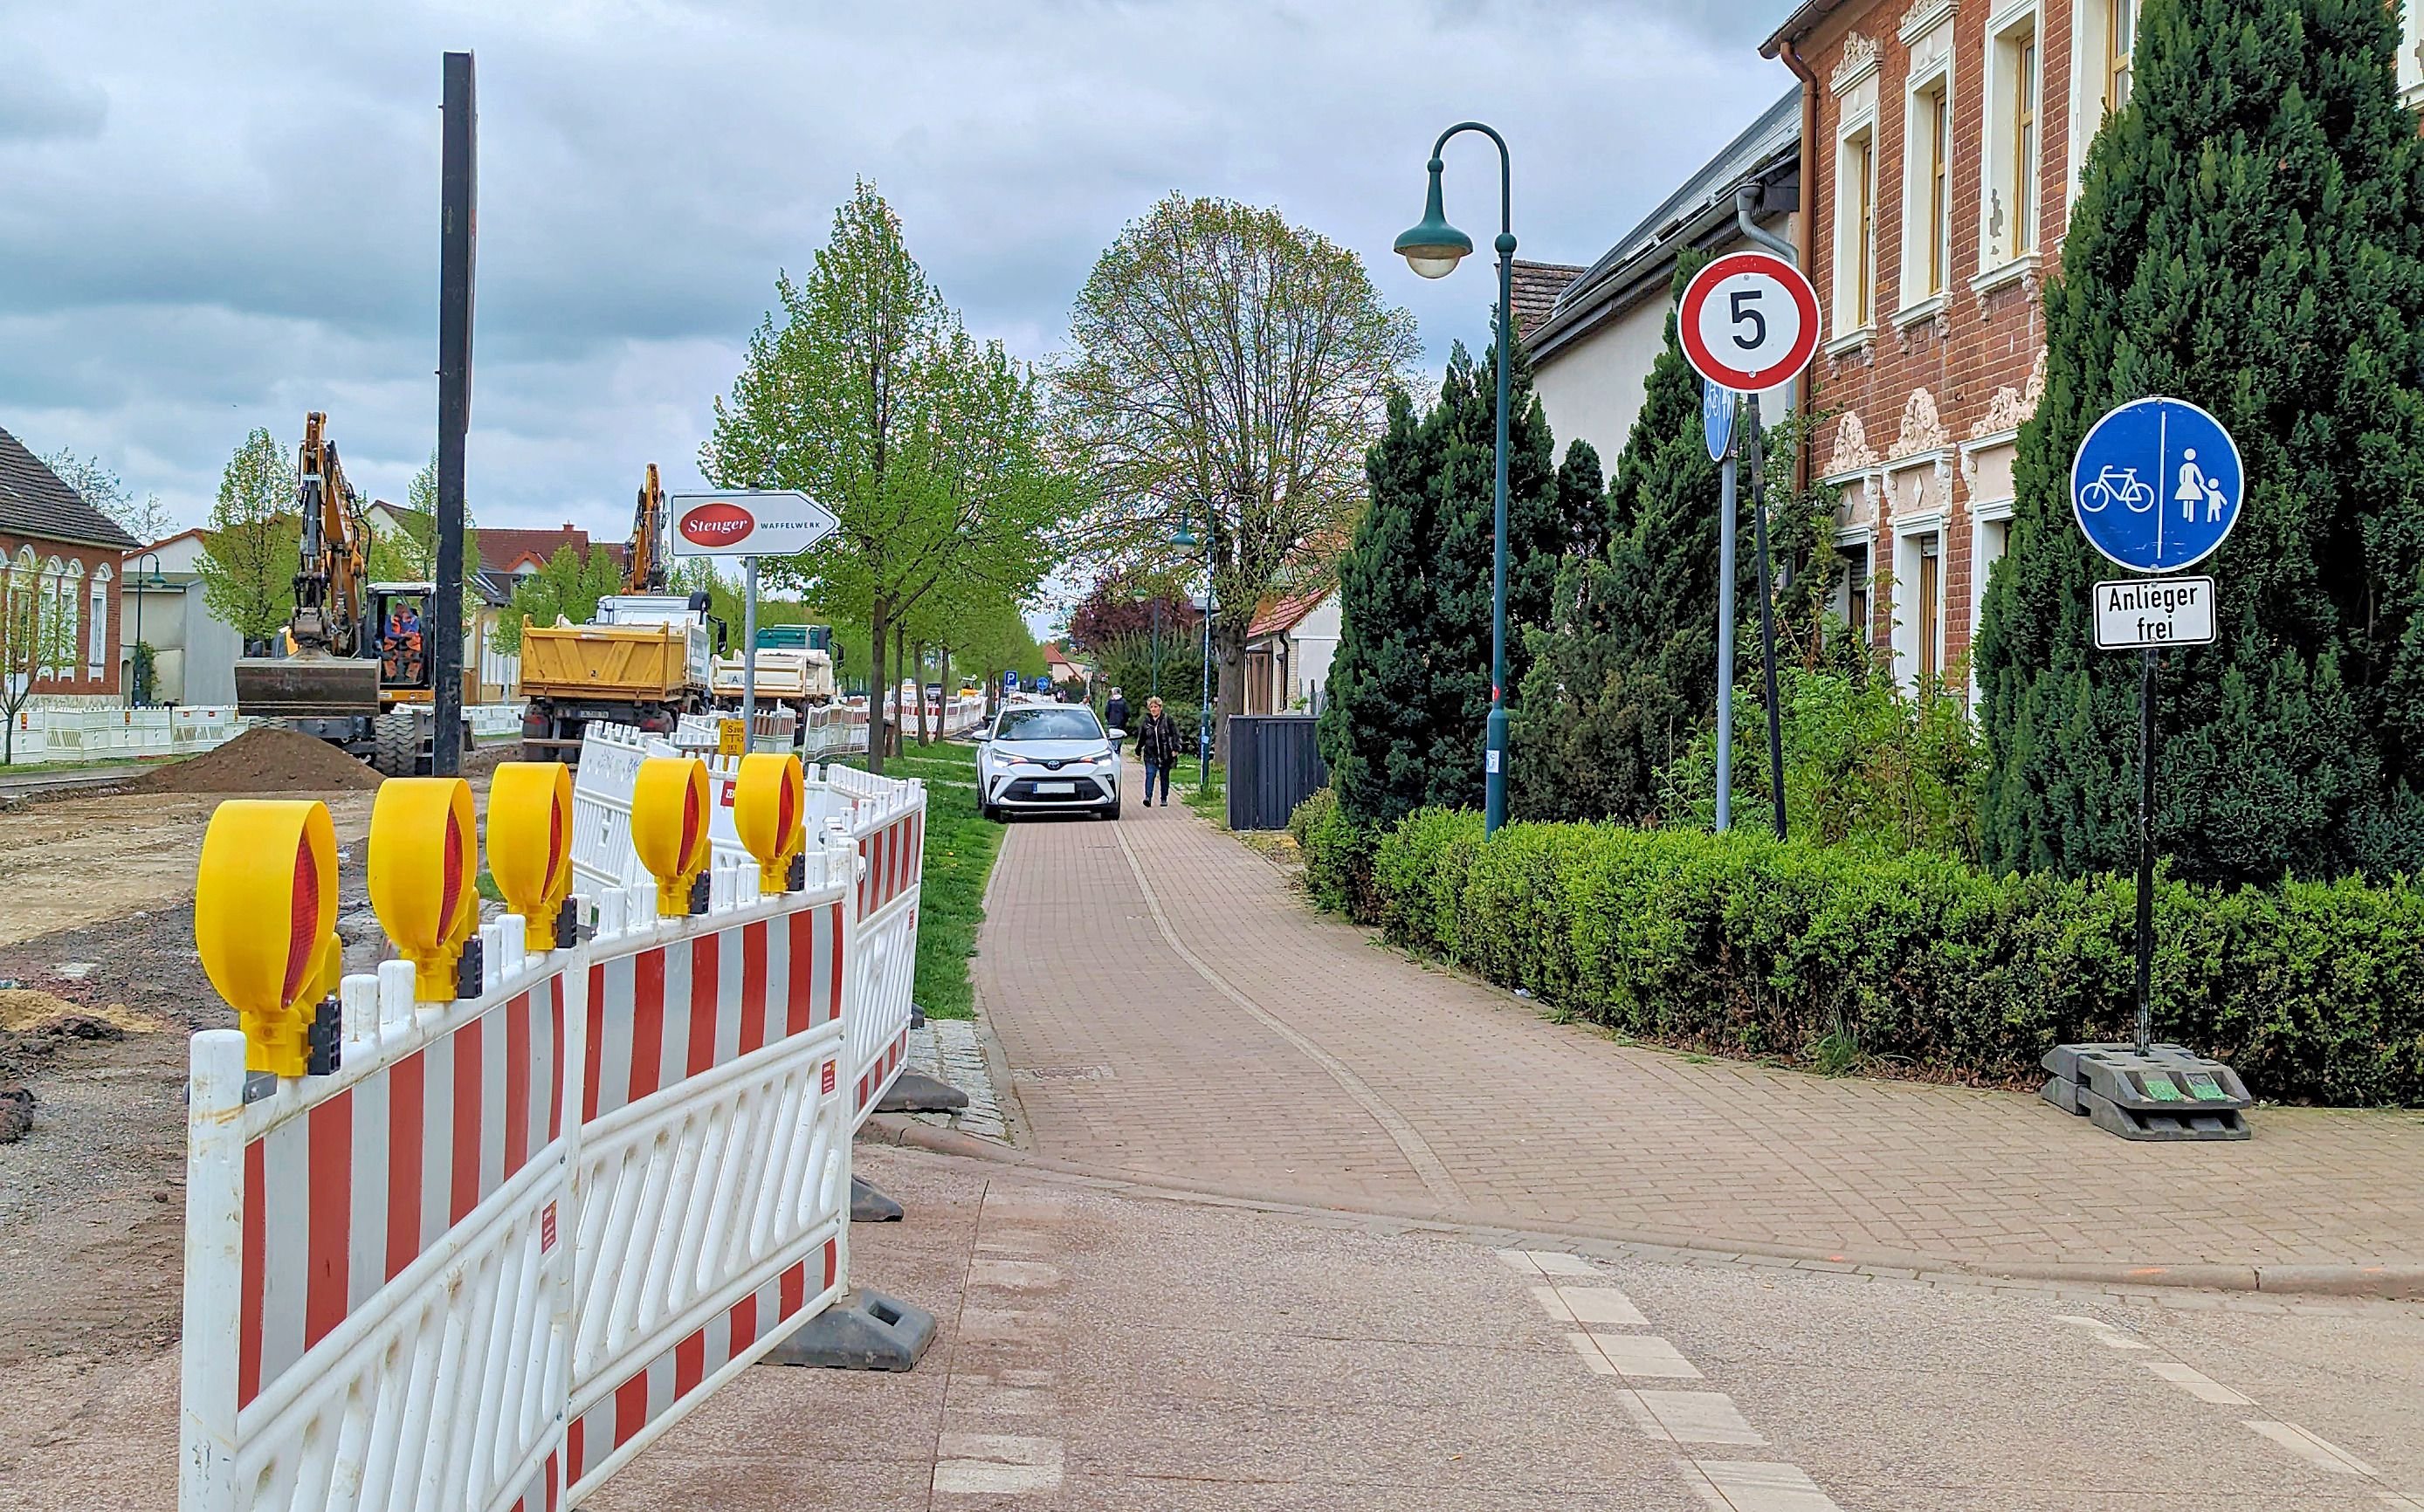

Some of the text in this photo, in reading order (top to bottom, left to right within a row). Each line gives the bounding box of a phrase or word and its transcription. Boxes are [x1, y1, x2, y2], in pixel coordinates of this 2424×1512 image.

[1731, 290, 1766, 350] 5
[688, 518, 748, 534] Stenger
[2109, 585, 2198, 613] Anlieger
[2137, 615, 2173, 641] frei
[1007, 673, 1015, 684] P
